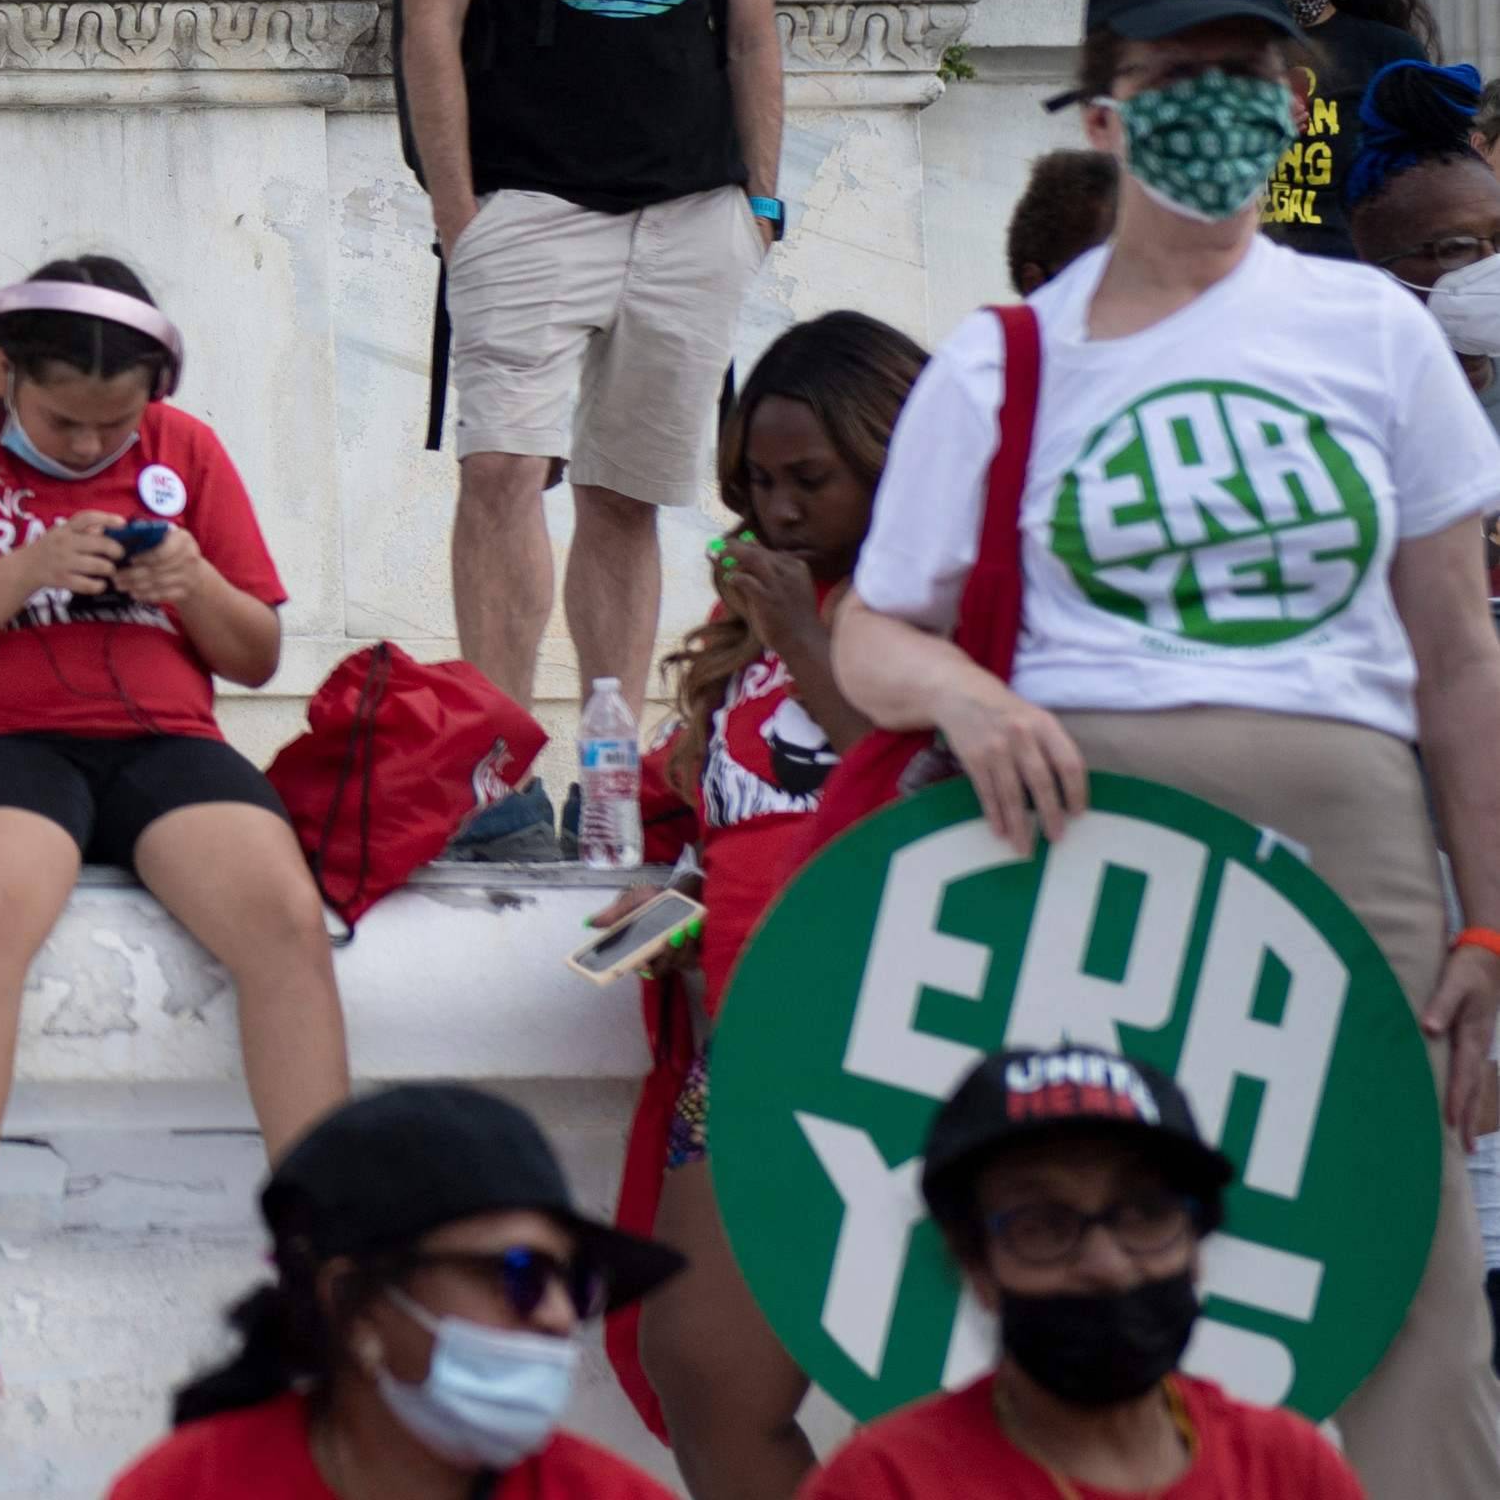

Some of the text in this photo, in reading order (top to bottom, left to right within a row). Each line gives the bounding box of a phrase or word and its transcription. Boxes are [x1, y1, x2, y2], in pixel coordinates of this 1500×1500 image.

[1076, 390, 1349, 565] ERA
[1091, 516, 1360, 632] YES
[841, 809, 1351, 1200] ERA
